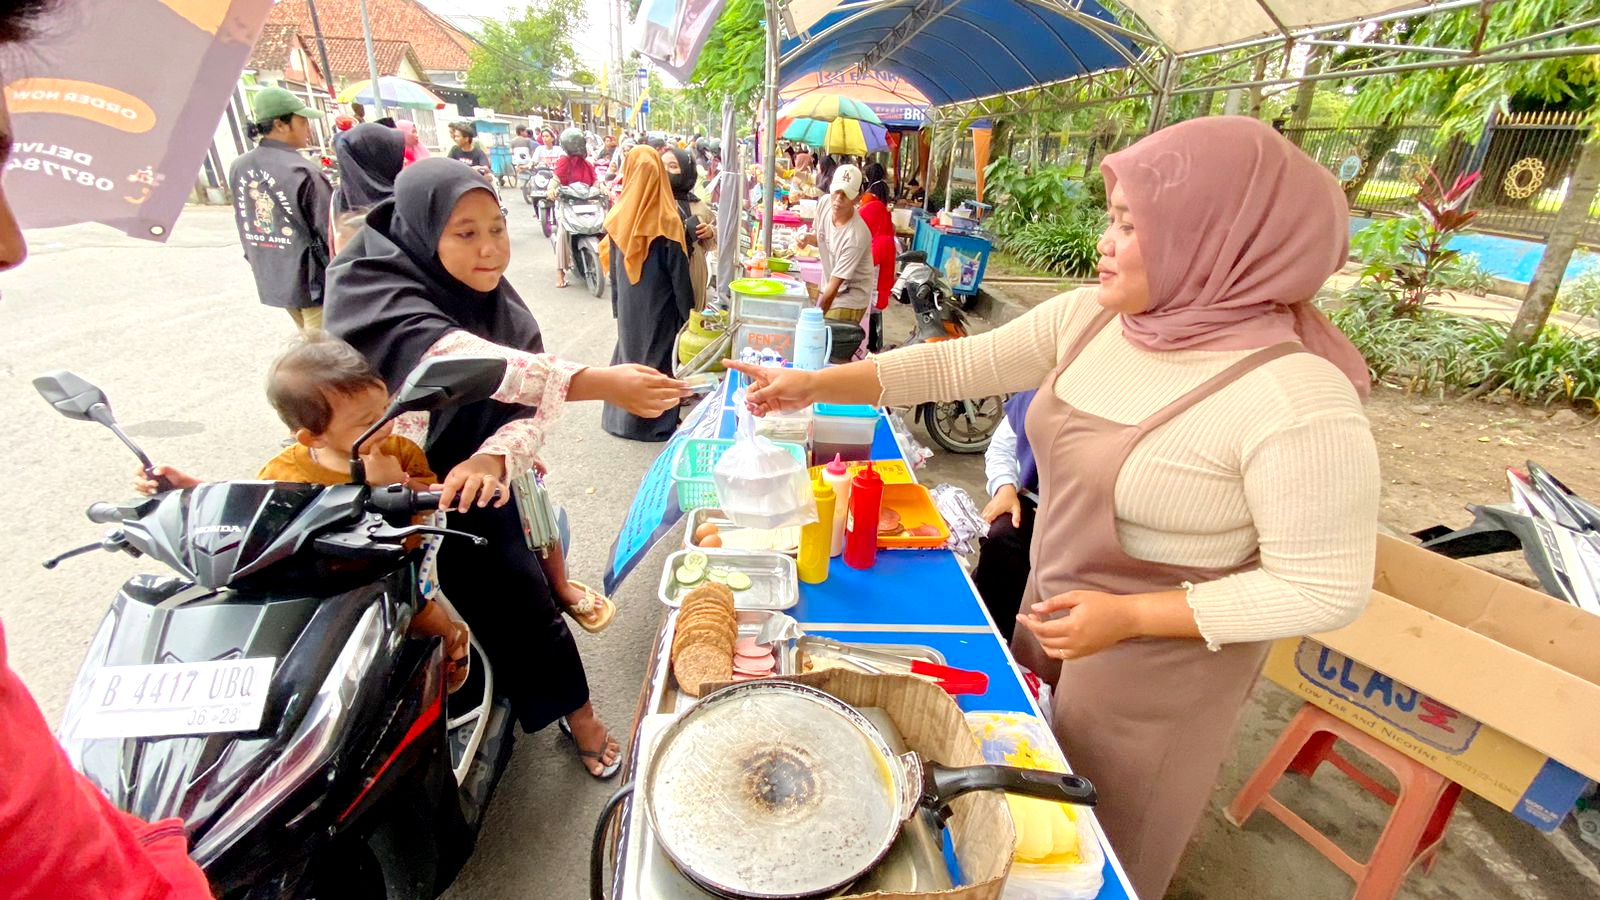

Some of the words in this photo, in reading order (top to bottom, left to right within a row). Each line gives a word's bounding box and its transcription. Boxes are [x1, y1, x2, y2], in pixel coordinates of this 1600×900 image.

[903, 109, 926, 121] BRI
[194, 525, 242, 534] HONDA
[101, 674, 121, 707] B
[134, 670, 199, 704] 4417
[208, 665, 255, 700] UBQ
